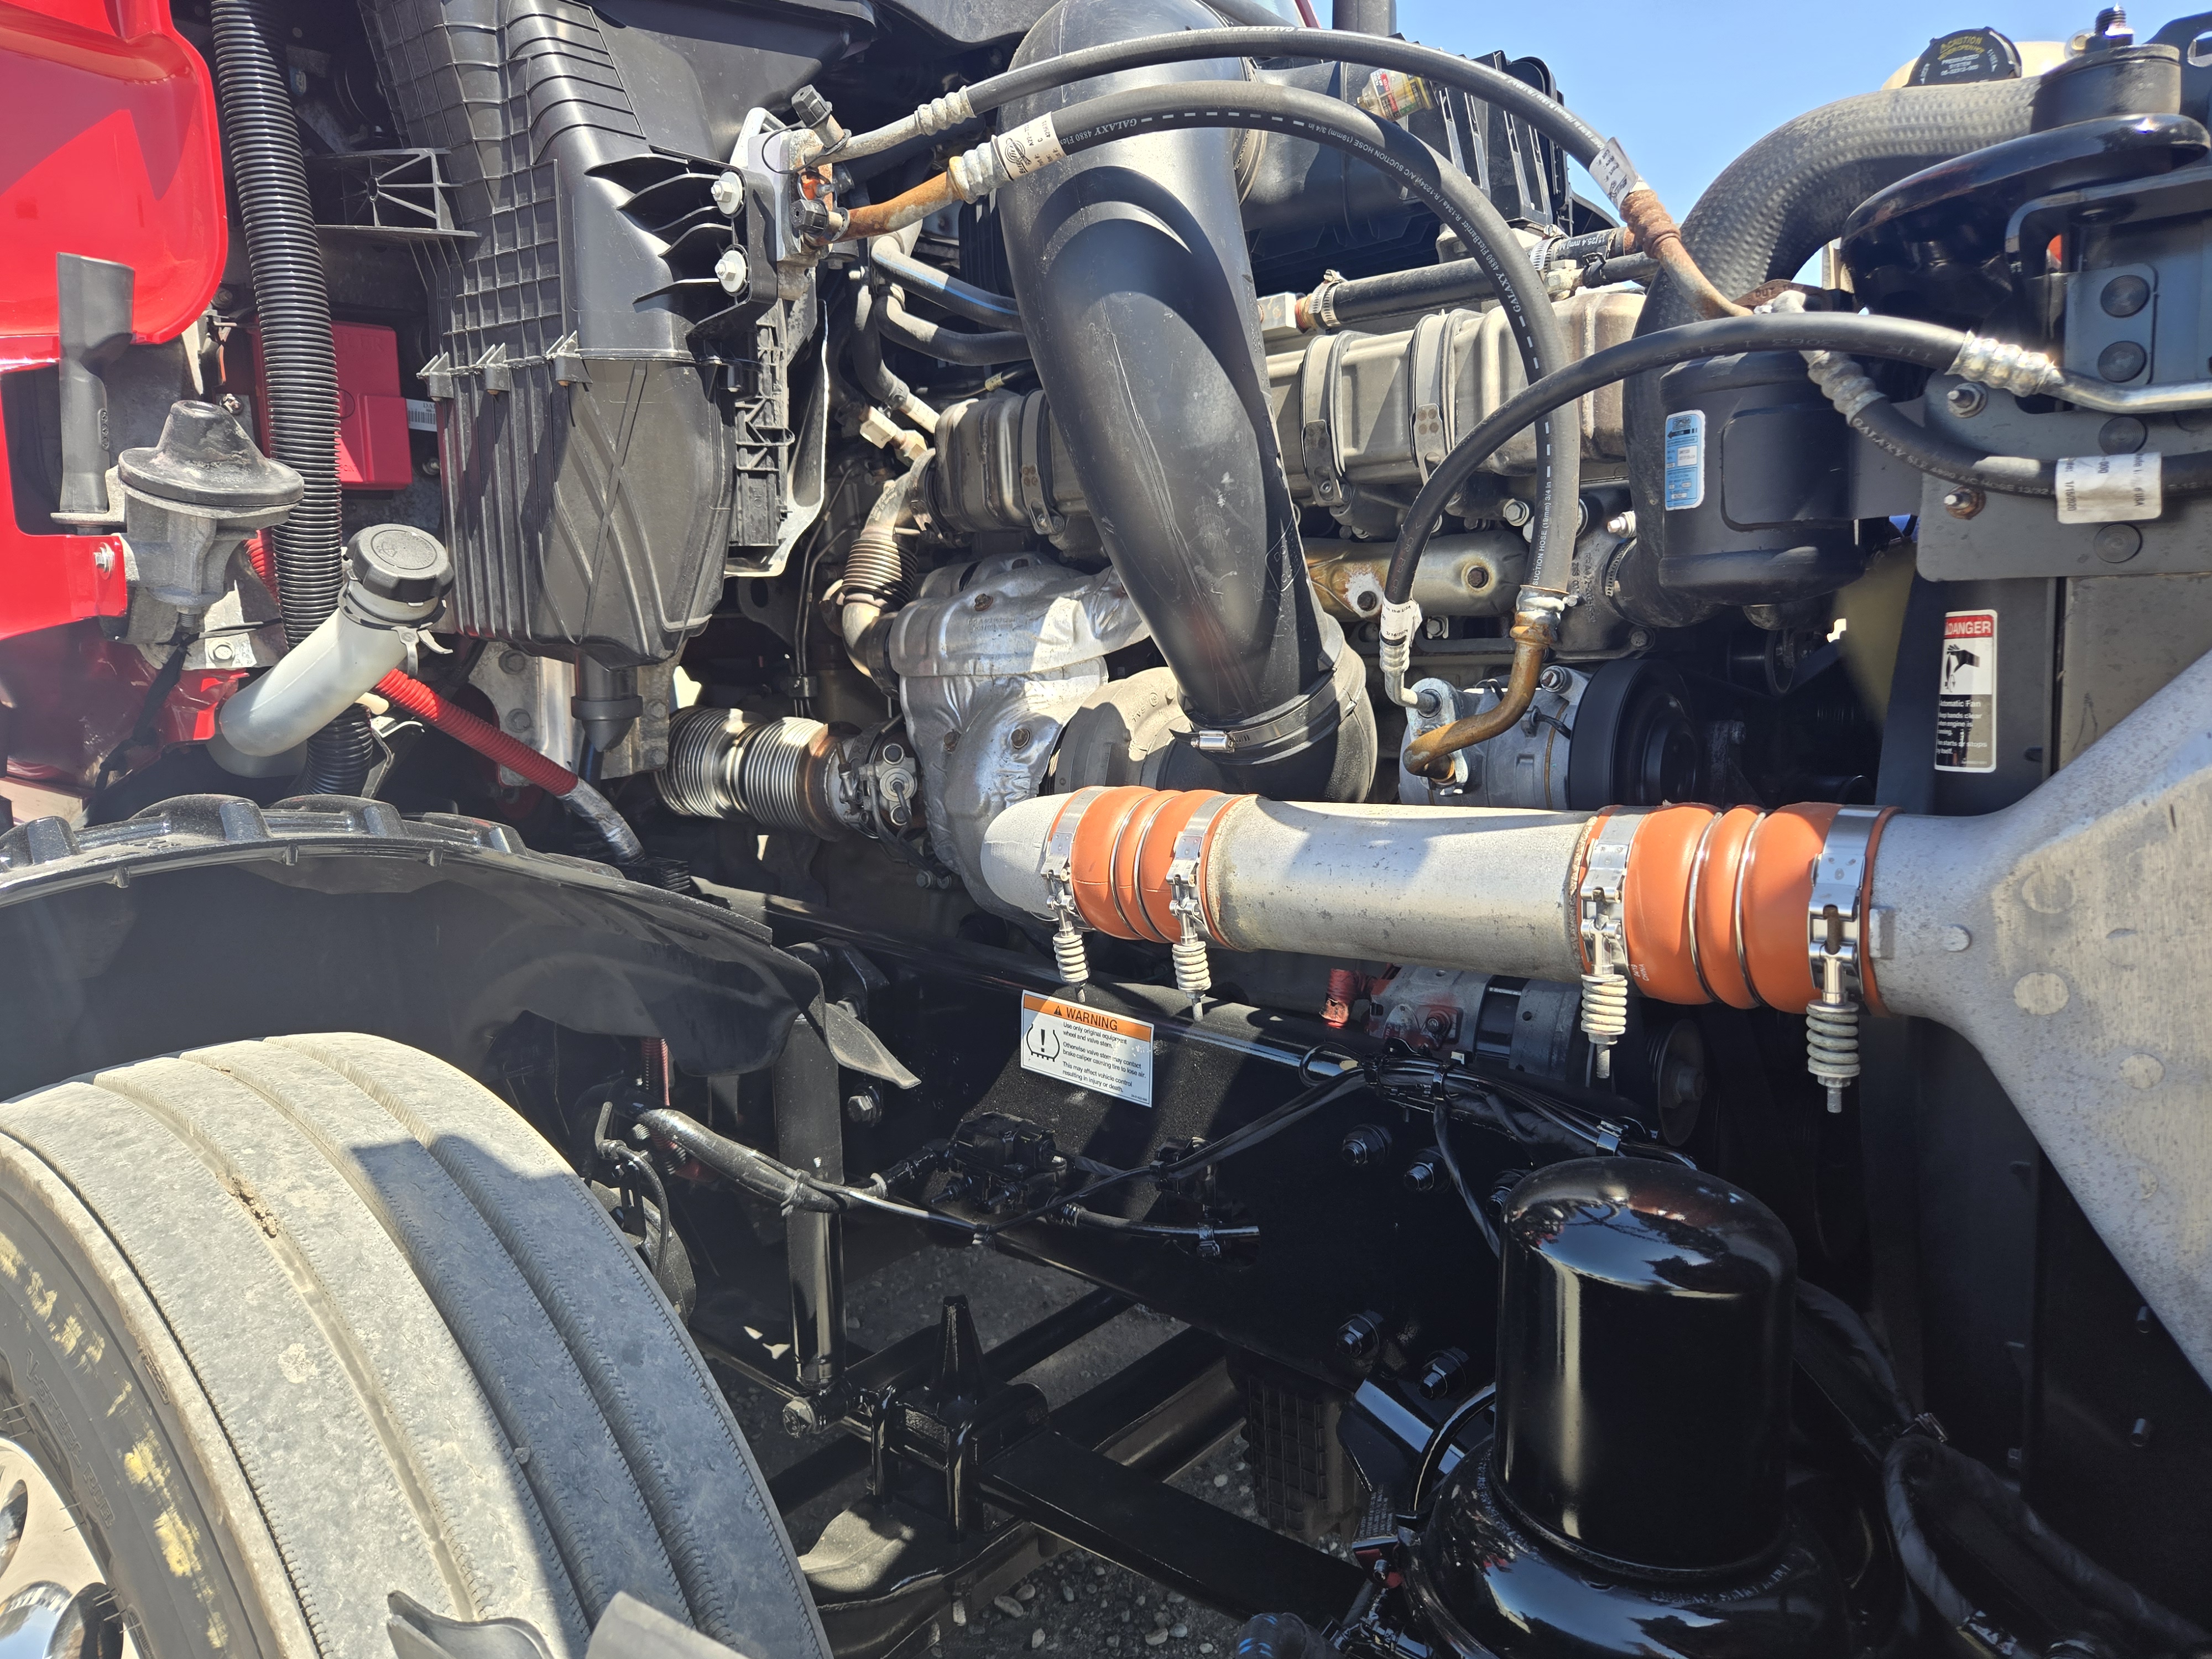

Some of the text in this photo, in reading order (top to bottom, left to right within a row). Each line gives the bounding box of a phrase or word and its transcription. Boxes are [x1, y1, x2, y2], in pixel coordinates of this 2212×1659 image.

[1076, 129, 1093, 142] 4880
[1094, 118, 1138, 136] GALAXY
[1316, 125, 1327, 133] 3/4
[1328, 128, 1353, 144] (19mm)
[1353, 139, 1375, 154] HOSE
[1374, 150, 1405, 172] SUCTION
[1609, 161, 1619, 175] Part
[1404, 169, 1417, 180] A/C
[1443, 200, 1462, 222] R-134a
[1461, 221, 1489, 257] FlexBarrier
[1485, 254, 1499, 271] 4880
[1495, 272, 1521, 313] GALAXY
[1853, 417, 1907, 458] GALAXY
[1958, 475, 1980, 486] A/C
[2133, 493, 2146, 507] USA
[1532, 552, 1544, 586] SUCTION
[1538, 529, 1548, 552] HOSE
[1543, 502, 1552, 529] (19mm)
[1391, 536, 1414, 594] CR PA CR
[1948, 620, 1992, 635] DANGER
[1639, 964, 1649, 981] CHINA
[1066, 1006, 1118, 1031] WARNING
[1084, 1028, 1101, 1037] original
[1102, 1033, 1127, 1044] equipment
[1063, 1041, 1086, 1052] Otherwise
[1123, 1059, 1141, 1068] contact
[1076, 1053, 1092, 1062] caliper
[1093, 1058, 1111, 1068] causing
[1062, 1070, 1082, 1080] resulting
[1088, 1076, 1103, 1086] injury
[1109, 1083, 1123, 1092] death.
[1083, 1067, 1097, 1076] affect
[1098, 1072, 1115, 1081] vehicle
[1115, 1077, 1132, 1087] control
[26, 1348, 116, 1530] V-STEEL RIB
